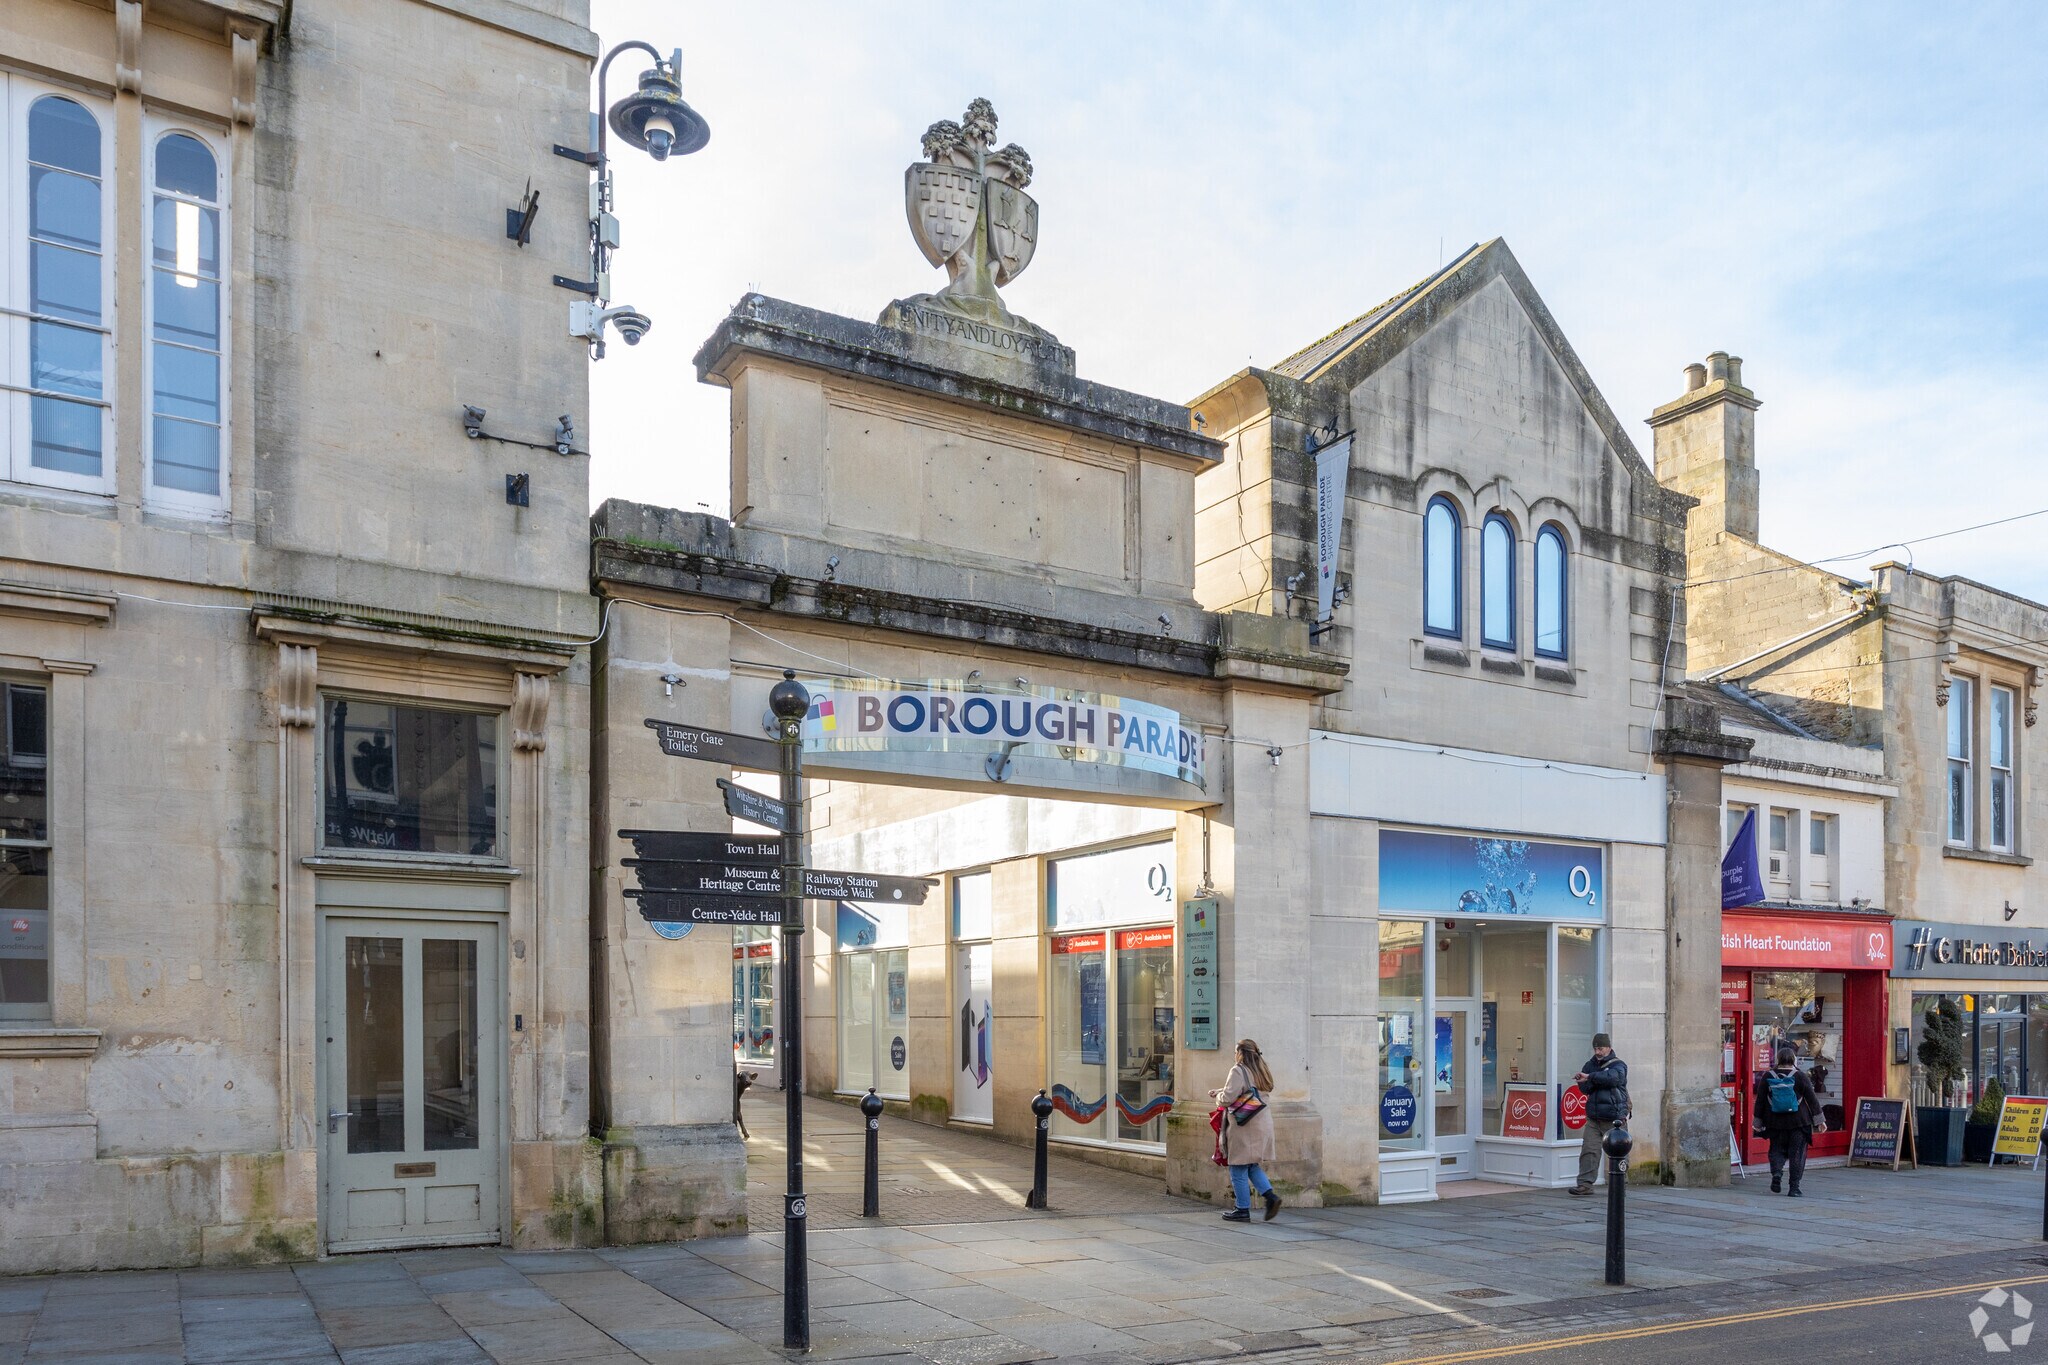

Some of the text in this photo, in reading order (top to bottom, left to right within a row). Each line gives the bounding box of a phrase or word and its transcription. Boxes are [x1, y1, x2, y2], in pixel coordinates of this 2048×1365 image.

[666, 726, 723, 746] Emery Gate
[858, 694, 1198, 769] BOROUGH PARADE
[667, 738, 698, 753] Toilets
[735, 788, 784, 815] Wiltshire & Swindon
[743, 804, 778, 825] History Centre
[725, 843, 780, 855] Town Hall
[725, 867, 780, 879] Museum &
[1730, 875, 1743, 884] flag
[700, 878, 780, 892] Heritage Centre
[806, 873, 878, 887] Railway Station
[806, 885, 874, 898] Riverside Walk
[692, 908, 781, 921] Centre-Yelde Hall
[13, 920, 28, 931] illy
[1144, 933, 1161, 941] Available
[1162, 932, 1172, 940] here
[1721, 933, 1831, 952] tish Heart Foundation
[1737, 980, 1748, 989] BHF
[1721, 991, 1739, 999] penham
[1384, 1098, 1413, 1107] January
[1390, 1107, 1406, 1117] Sale
